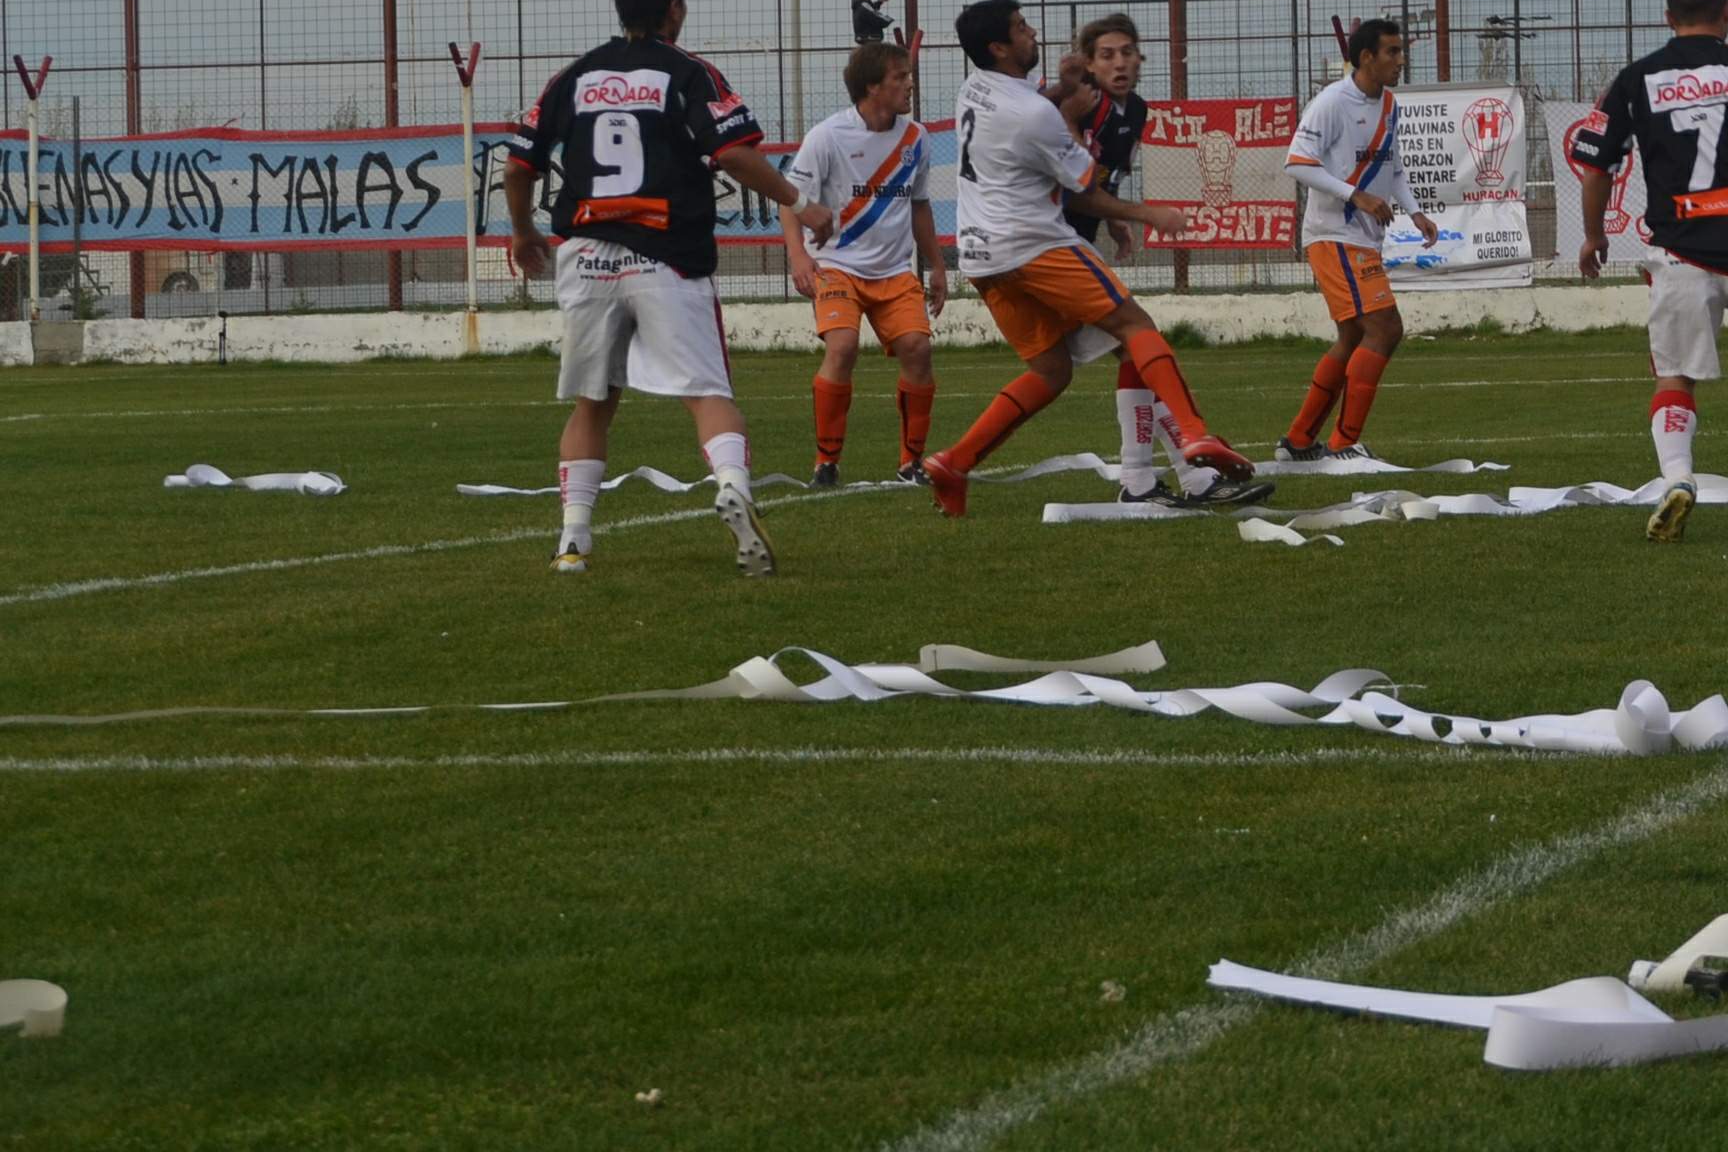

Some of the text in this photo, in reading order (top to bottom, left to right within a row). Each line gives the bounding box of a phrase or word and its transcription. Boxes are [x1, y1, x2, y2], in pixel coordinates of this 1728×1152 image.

[1235, 102, 1292, 142] ALE
[1478, 112, 1499, 139] H
[1427, 138, 1444, 150] EN
[1670, 104, 1726, 192] 7
[592, 112, 644, 197] 9
[1400, 153, 1454, 168] ORAZON
[1407, 170, 1457, 184] ENTARE
[248, 150, 441, 235] MALAS
[1463, 189, 1519, 201] HURACAN
[1473, 231, 1523, 244] MI GLOBITO
[1477, 248, 1519, 260] QUERIDO!
